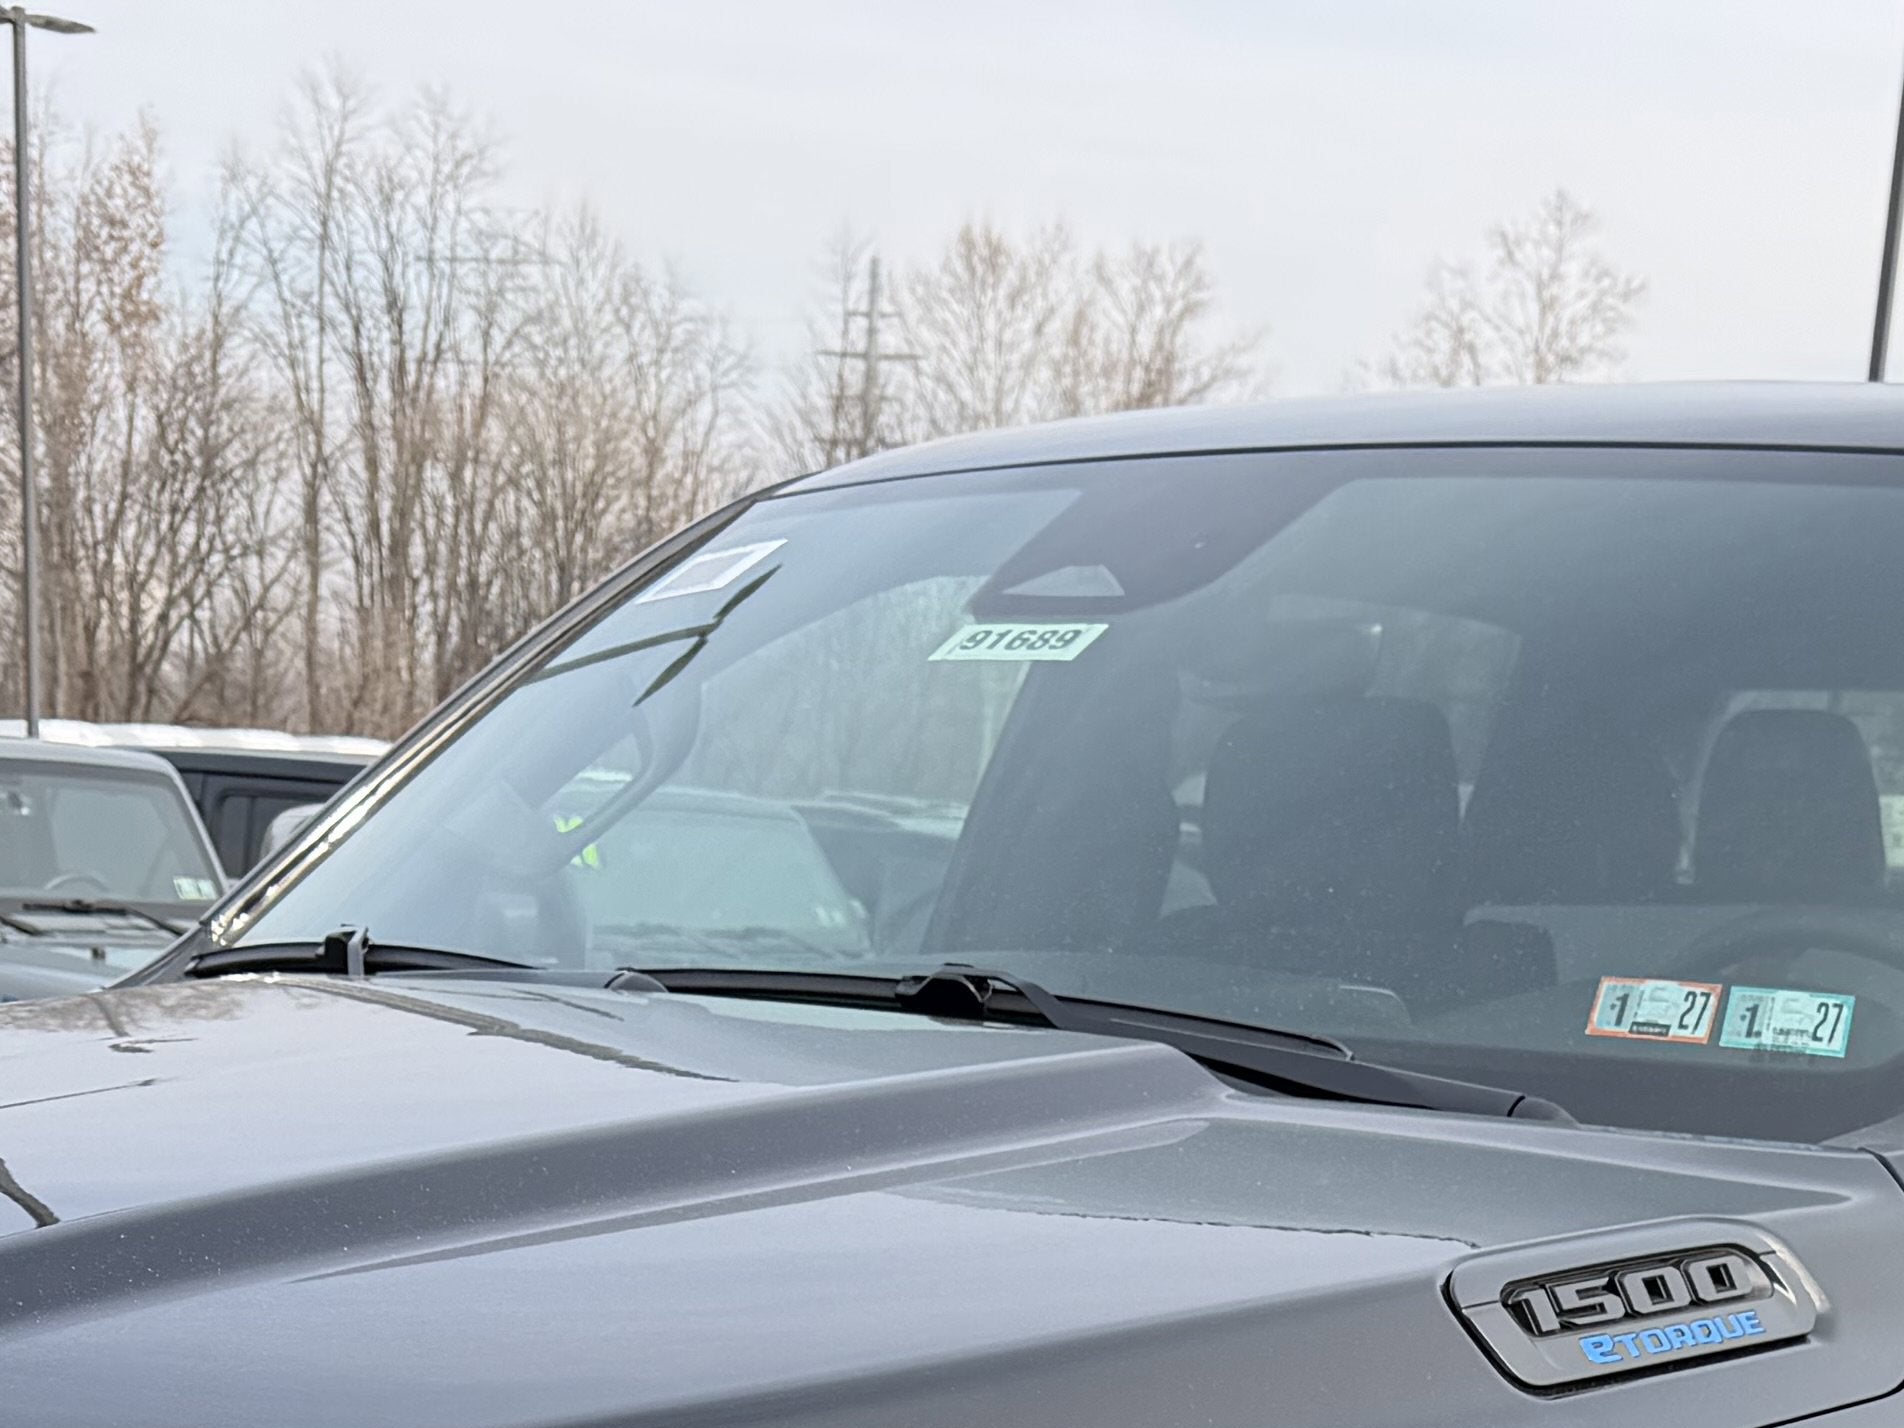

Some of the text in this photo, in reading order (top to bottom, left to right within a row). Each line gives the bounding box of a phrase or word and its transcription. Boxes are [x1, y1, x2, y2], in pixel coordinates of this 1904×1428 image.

[959, 629, 1083, 650] 91689
[1677, 990, 1712, 1035] 27
[1811, 1001, 1844, 1045] 27
[1509, 1254, 1754, 1336] 1500
